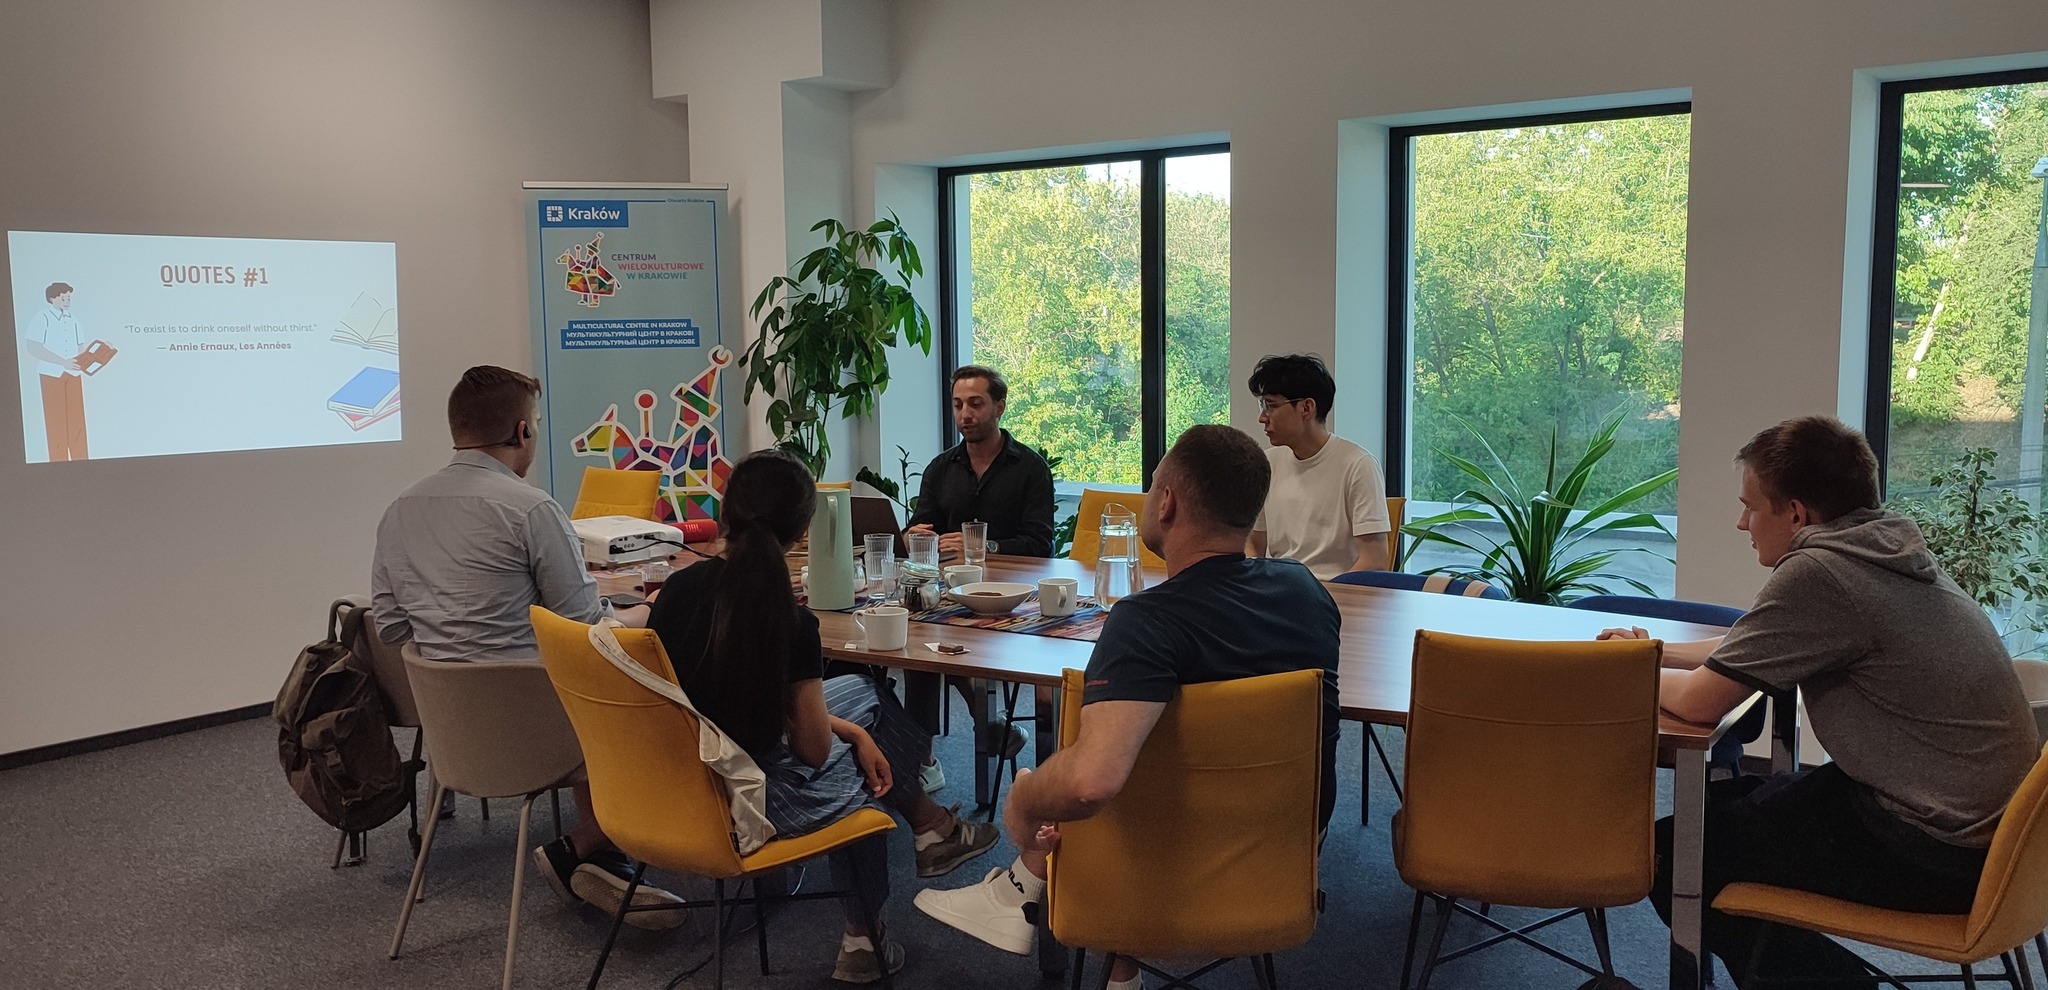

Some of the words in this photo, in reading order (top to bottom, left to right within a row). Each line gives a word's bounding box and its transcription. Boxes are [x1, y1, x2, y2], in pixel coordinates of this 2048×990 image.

[568, 206, 621, 220] Kraków
[611, 253, 656, 261] CENTRUM
[618, 262, 704, 271] WIELOKULTUROWE
[160, 264, 236, 288] QUOTES
[243, 267, 268, 288] #1
[626, 272, 637, 280] W
[638, 272, 688, 280] KRAKOWIE
[143, 324, 166, 334] exist
[168, 324, 177, 333] is
[178, 325, 189, 333] to
[190, 324, 215, 333] drink
[217, 323, 251, 333] oneself
[253, 323, 288, 332] without
[169, 342, 199, 351] Annie
[200, 342, 237, 352] Ernaux,
[239, 342, 255, 350] Les
[256, 341, 292, 350] Années
[960, 824, 975, 846] N
[1008, 867, 1025, 894] ILA
